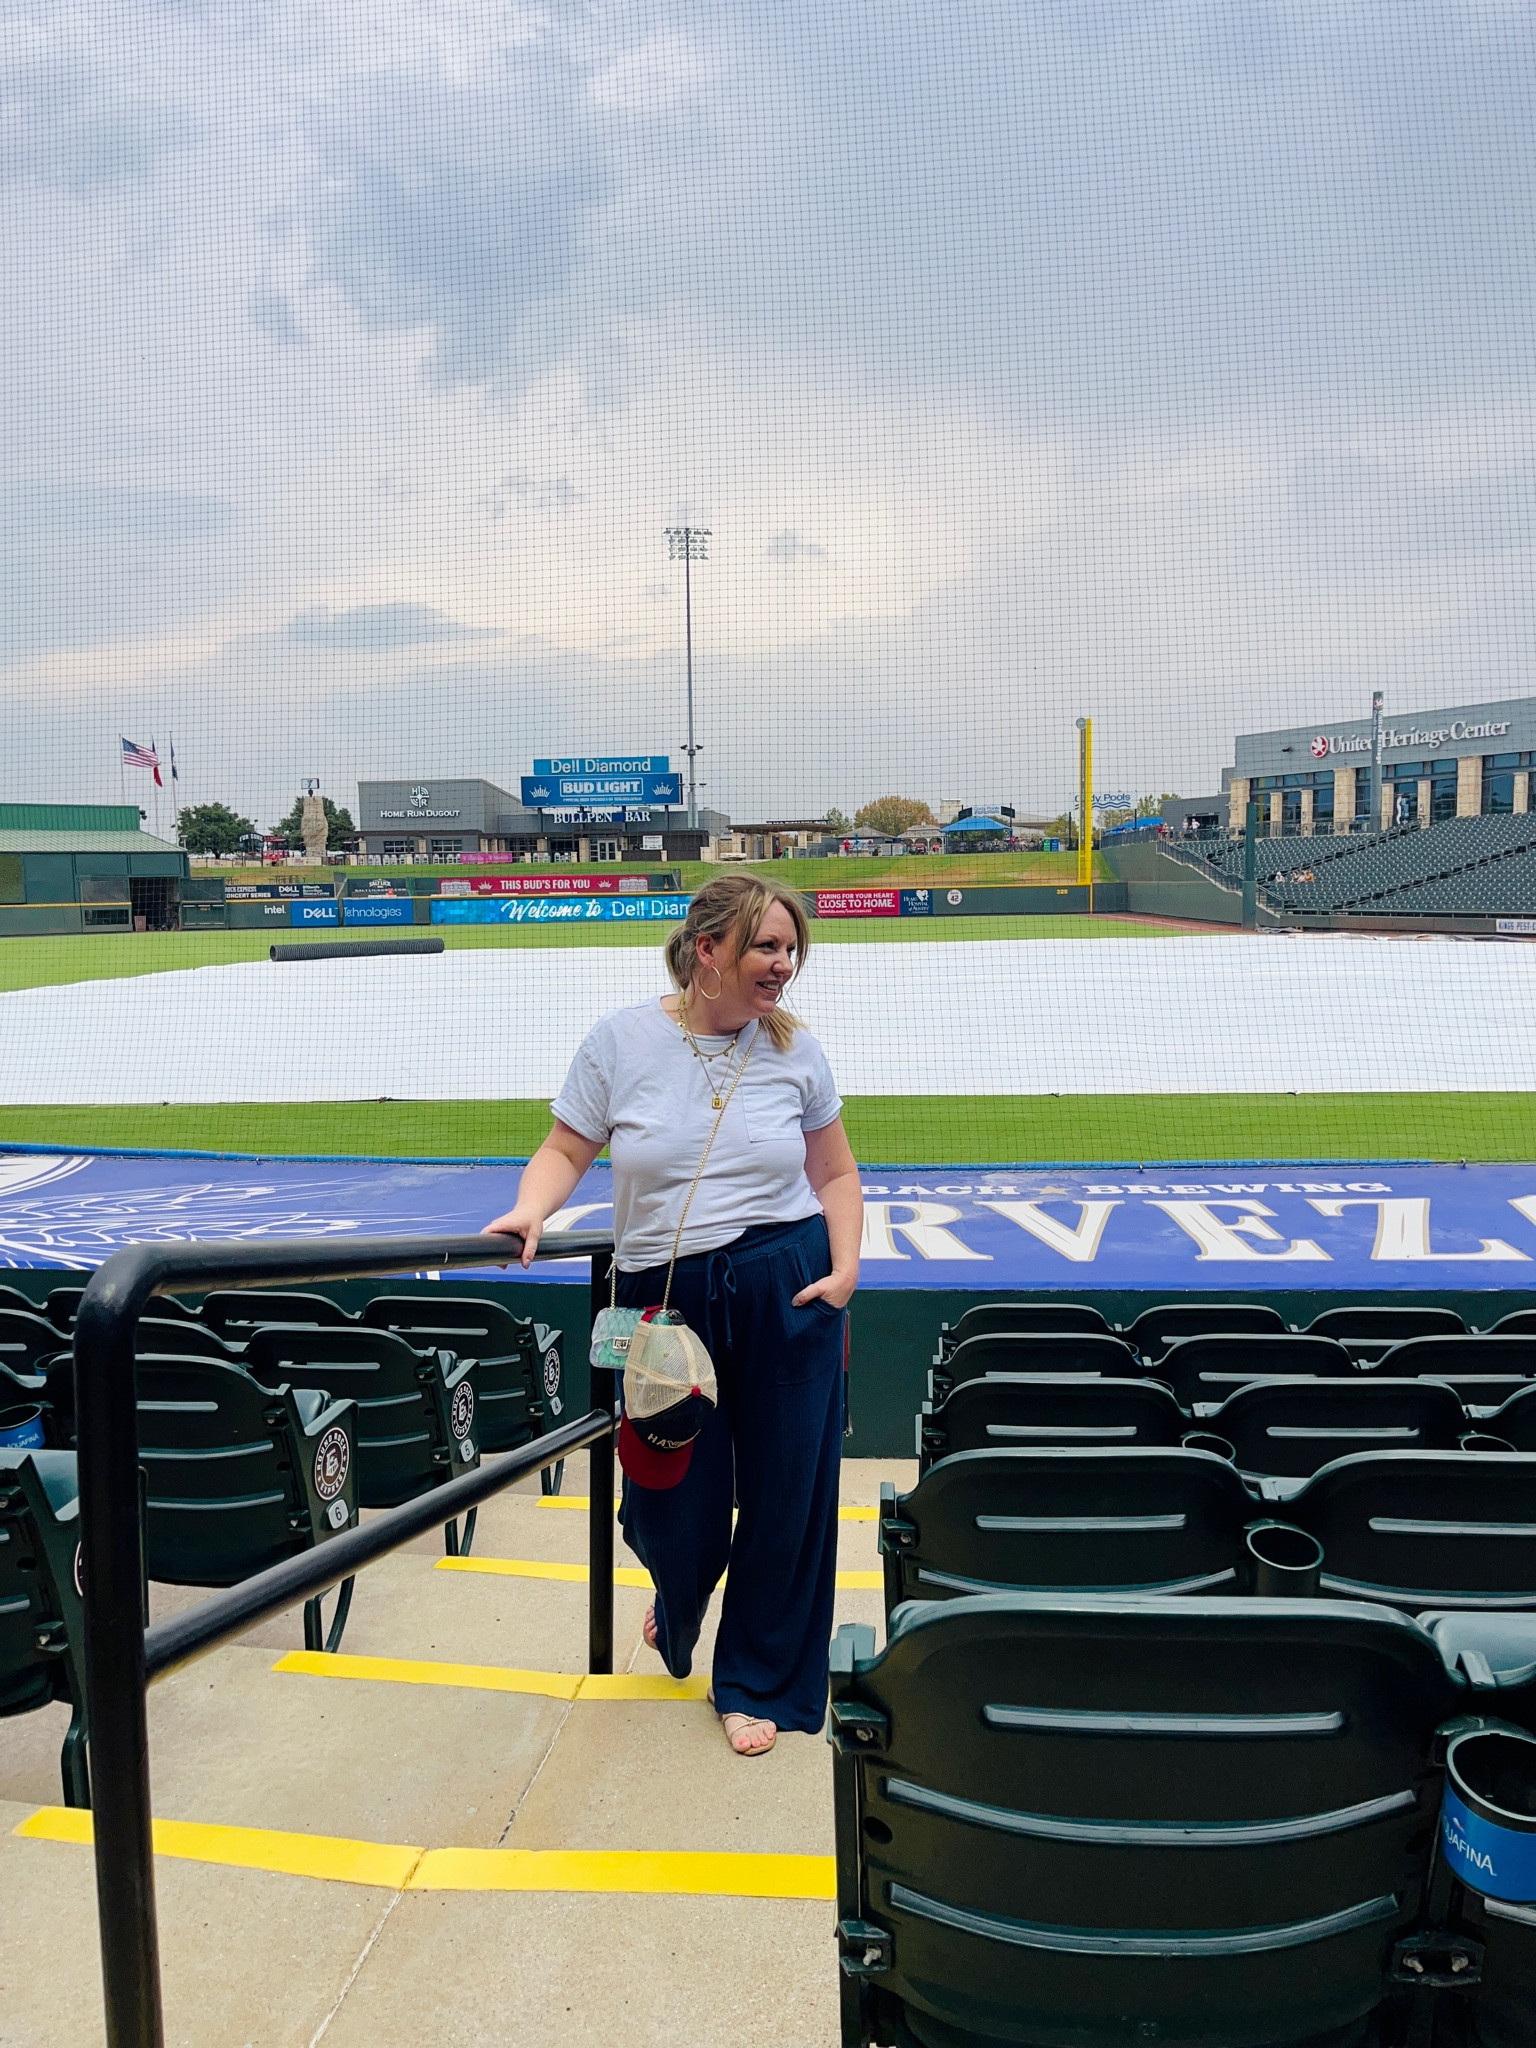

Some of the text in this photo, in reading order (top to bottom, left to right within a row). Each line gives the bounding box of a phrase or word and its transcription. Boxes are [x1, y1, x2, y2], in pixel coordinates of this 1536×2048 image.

[1381, 727, 1450, 748] Heritage
[1450, 721, 1511, 740] Center
[551, 758, 651, 774] Dell Diamond
[562, 781, 641, 794] BUD LIGHT
[1103, 793, 1131, 802] Pools
[553, 811, 651, 824] BULLPEN BAR
[279, 885, 300, 893] DELL
[500, 879, 590, 890] THIS BUD'S FOR YOU
[818, 899, 895, 908] CLOSE TO HOME.
[950, 894, 959, 902] 42
[303, 907, 336, 919] DELL
[501, 900, 583, 921] Welcome
[585, 898, 603, 918] to
[611, 900, 645, 917] Dell
[862, 1182, 1393, 1195] BACH BREWING
[464, 1444, 471, 1456] 5
[334, 1506, 343, 1521] 6
